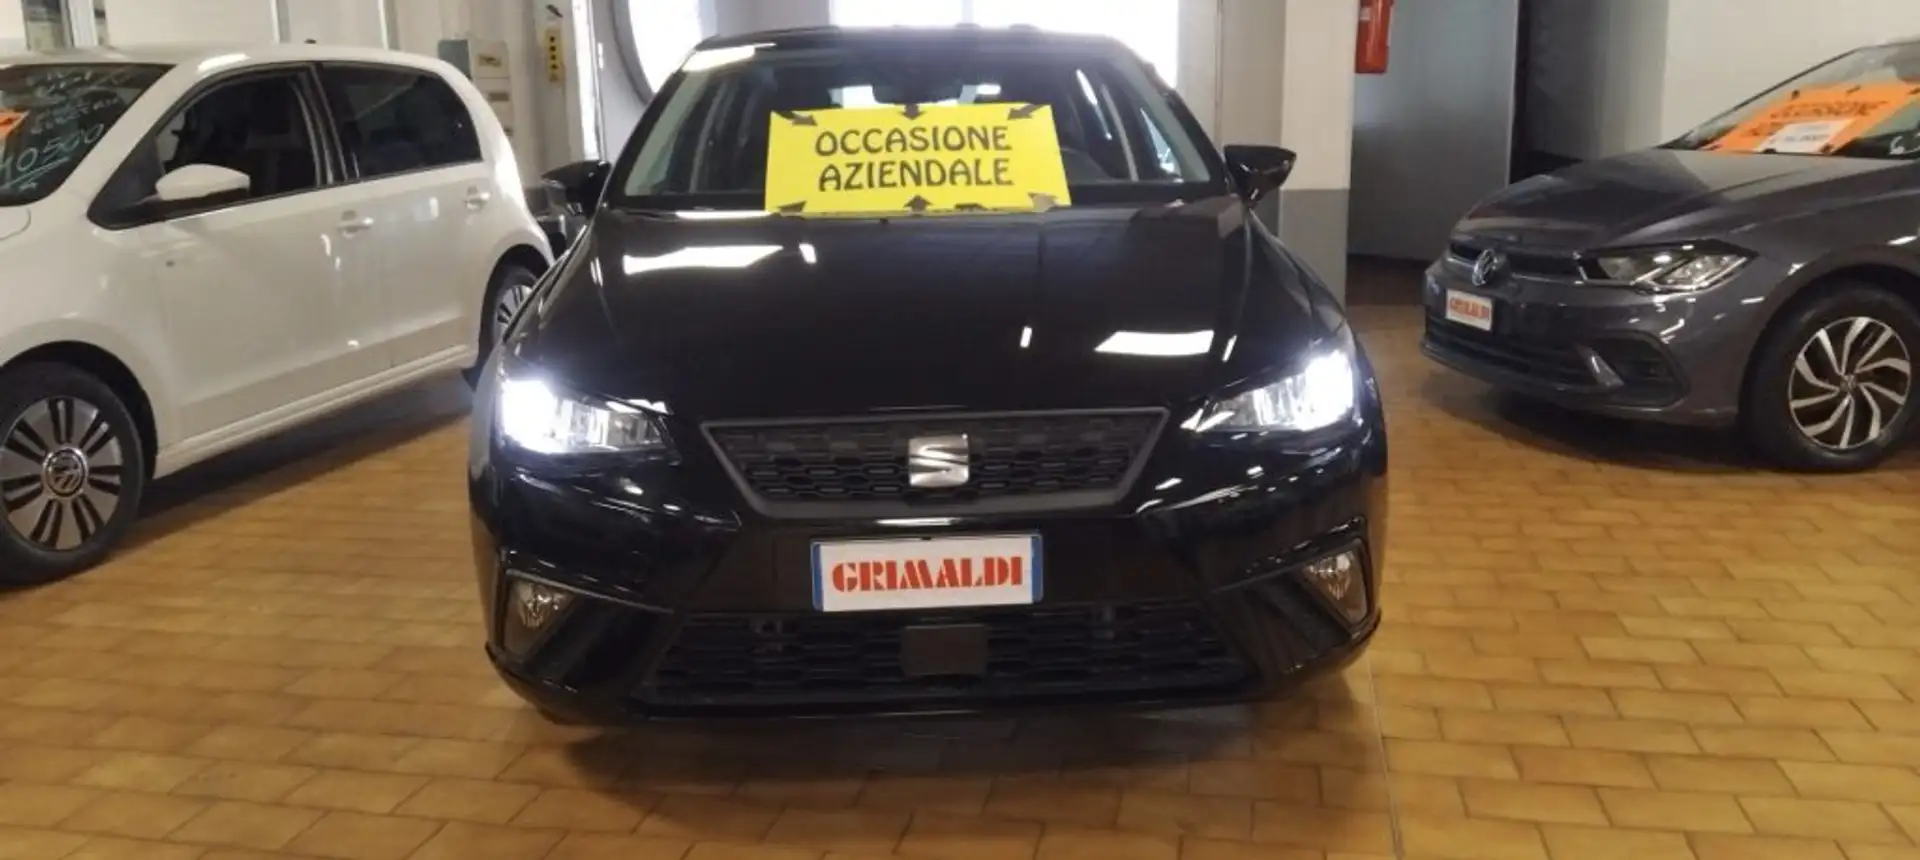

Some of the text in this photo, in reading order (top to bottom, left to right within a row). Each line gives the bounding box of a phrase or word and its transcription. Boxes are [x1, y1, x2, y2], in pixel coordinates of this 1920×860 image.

[815, 126, 1012, 157] OCCASIONE
[818, 158, 1014, 192] AZIENDALE
[832, 556, 1023, 593] GRIMALDI
